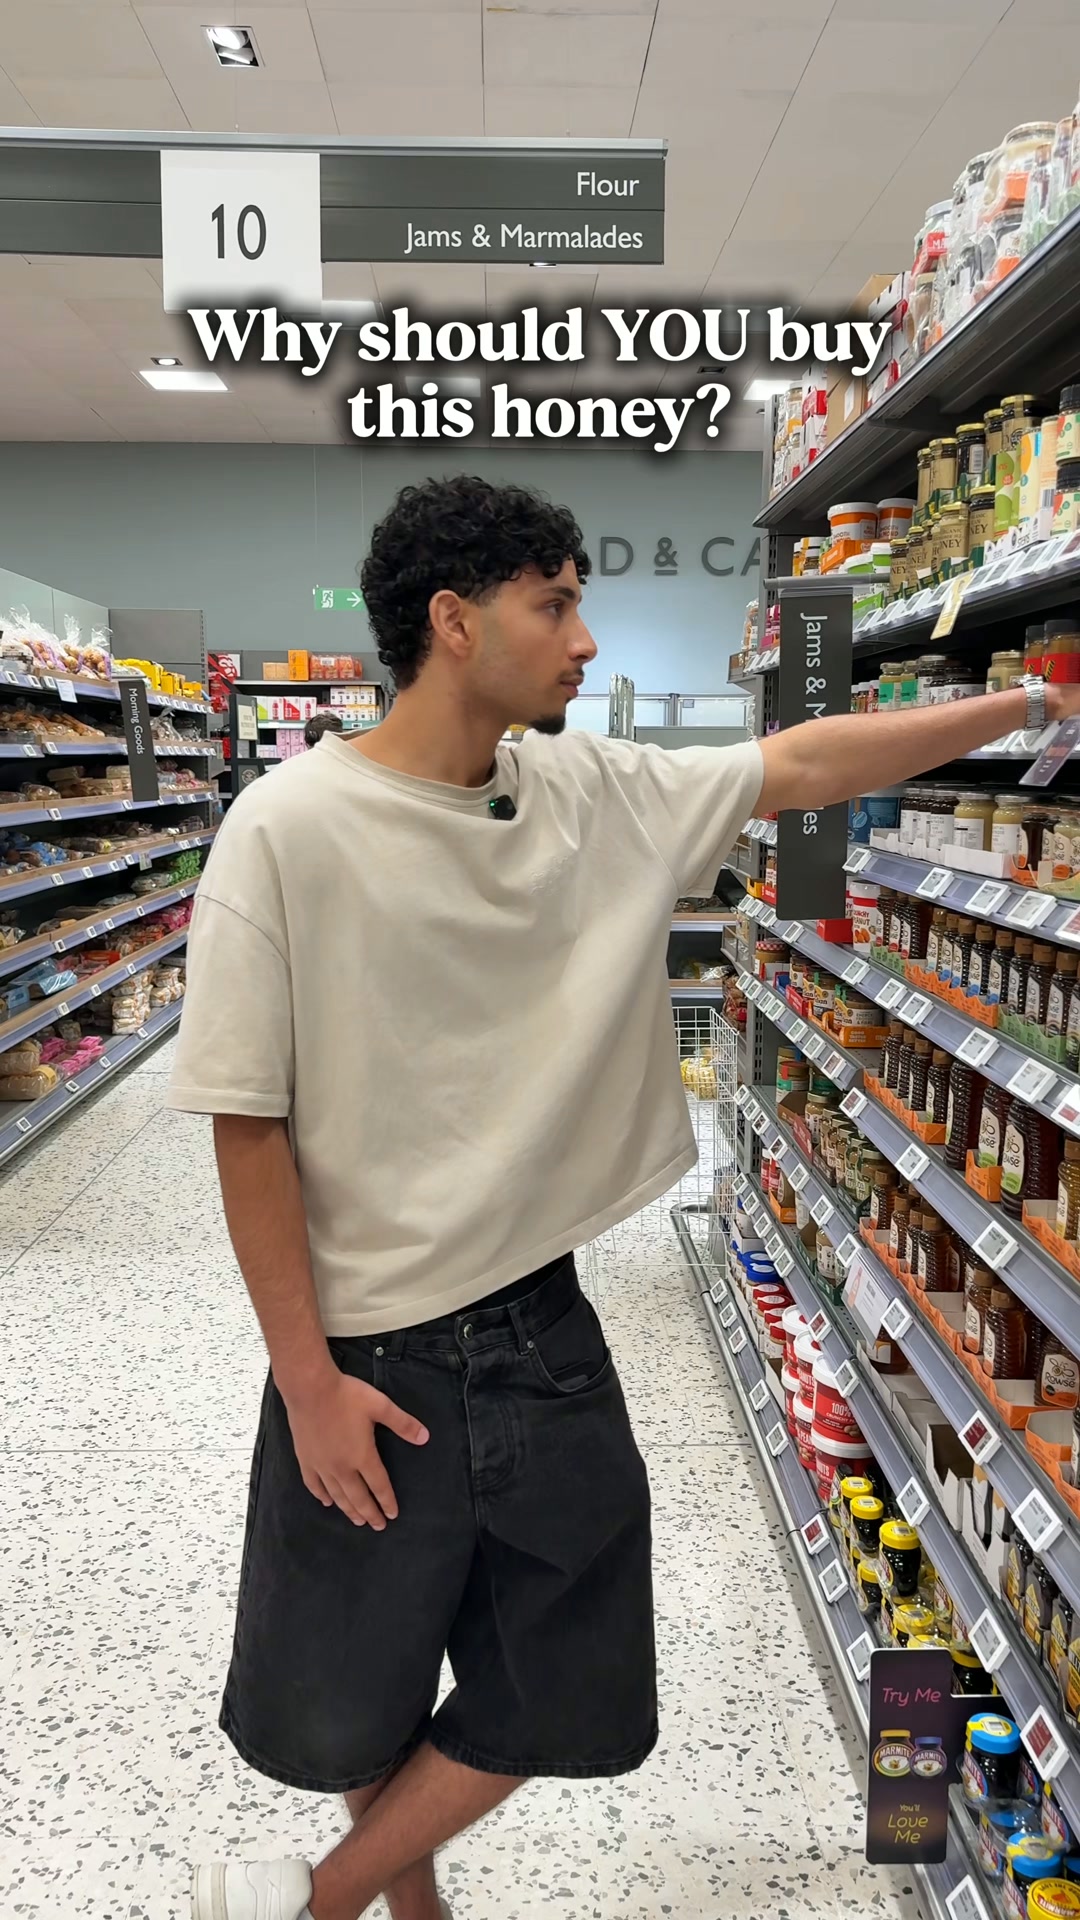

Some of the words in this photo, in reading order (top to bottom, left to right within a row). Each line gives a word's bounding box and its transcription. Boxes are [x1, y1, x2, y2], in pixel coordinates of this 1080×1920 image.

[577, 171, 640, 197] Flour
[211, 203, 267, 261] 10
[404, 222, 462, 254] Jams
[472, 223, 492, 248] &
[501, 223, 643, 249] Marmalades
[653, 536, 679, 576] &
[800, 613, 828, 668] Jams
[805, 676, 827, 695] &
[128, 688, 140, 724] Morning
[134, 725, 146, 755] Goods
[1045, 1371, 1076, 1388] Rowse
[882, 1687, 909, 1707] Try
[915, 1687, 942, 1703] Me
[879, 1745, 912, 1758] MARMITE
[914, 1751, 943, 1763] MARMITE
[899, 1804, 921, 1812] You'll
[887, 1813, 929, 1829] Love
[894, 1830, 921, 1844] Me
